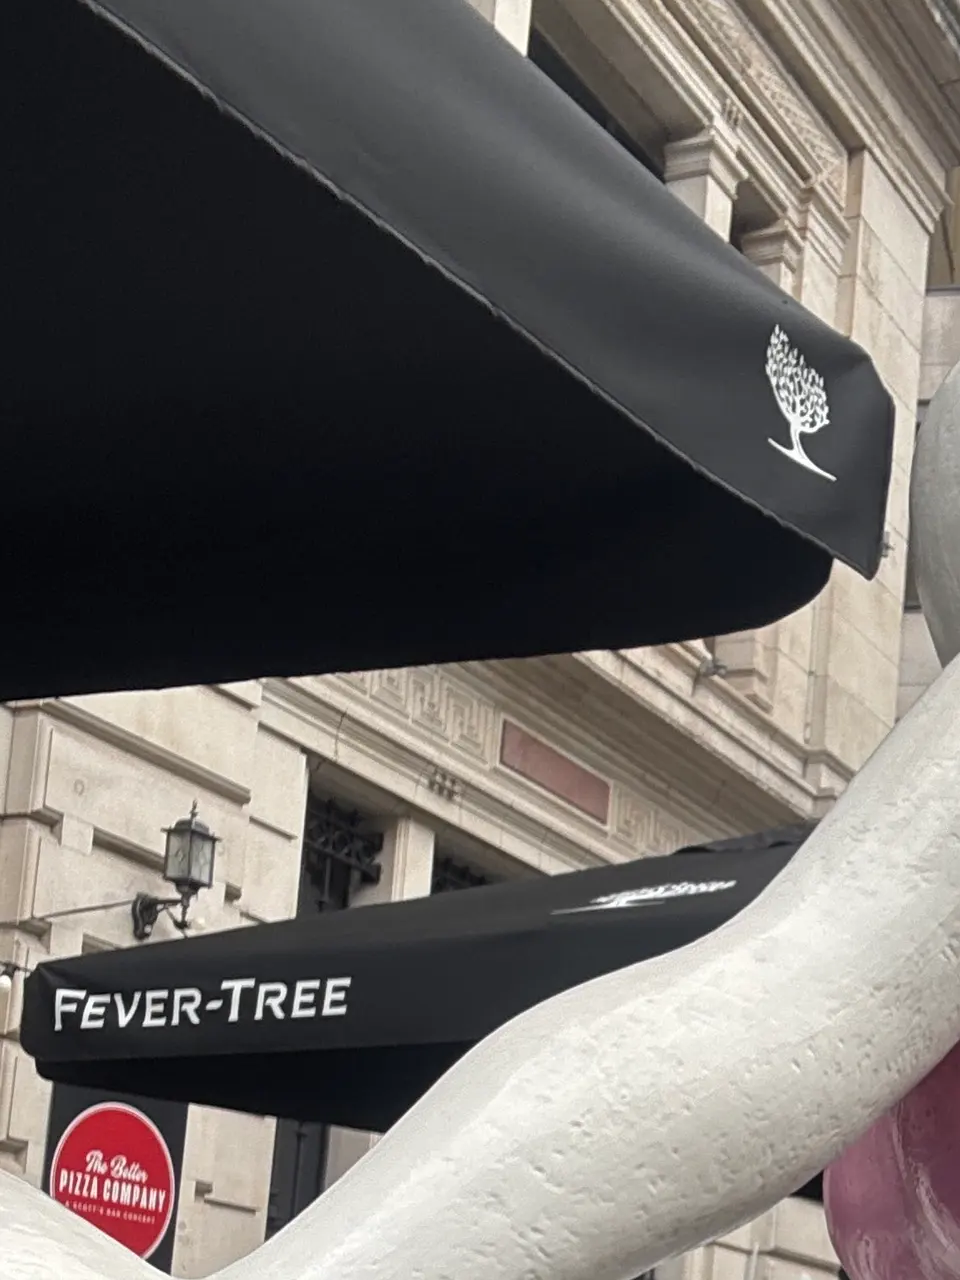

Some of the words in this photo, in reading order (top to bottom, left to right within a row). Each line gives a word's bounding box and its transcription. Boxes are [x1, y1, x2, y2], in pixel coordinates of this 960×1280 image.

[54, 977, 352, 1031] FEVER-TREE
[85, 1149, 108, 1175] The
[110, 1154, 149, 1184] Better
[59, 1168, 98, 1199] PIZZA
[103, 1178, 166, 1213] COMPANY
